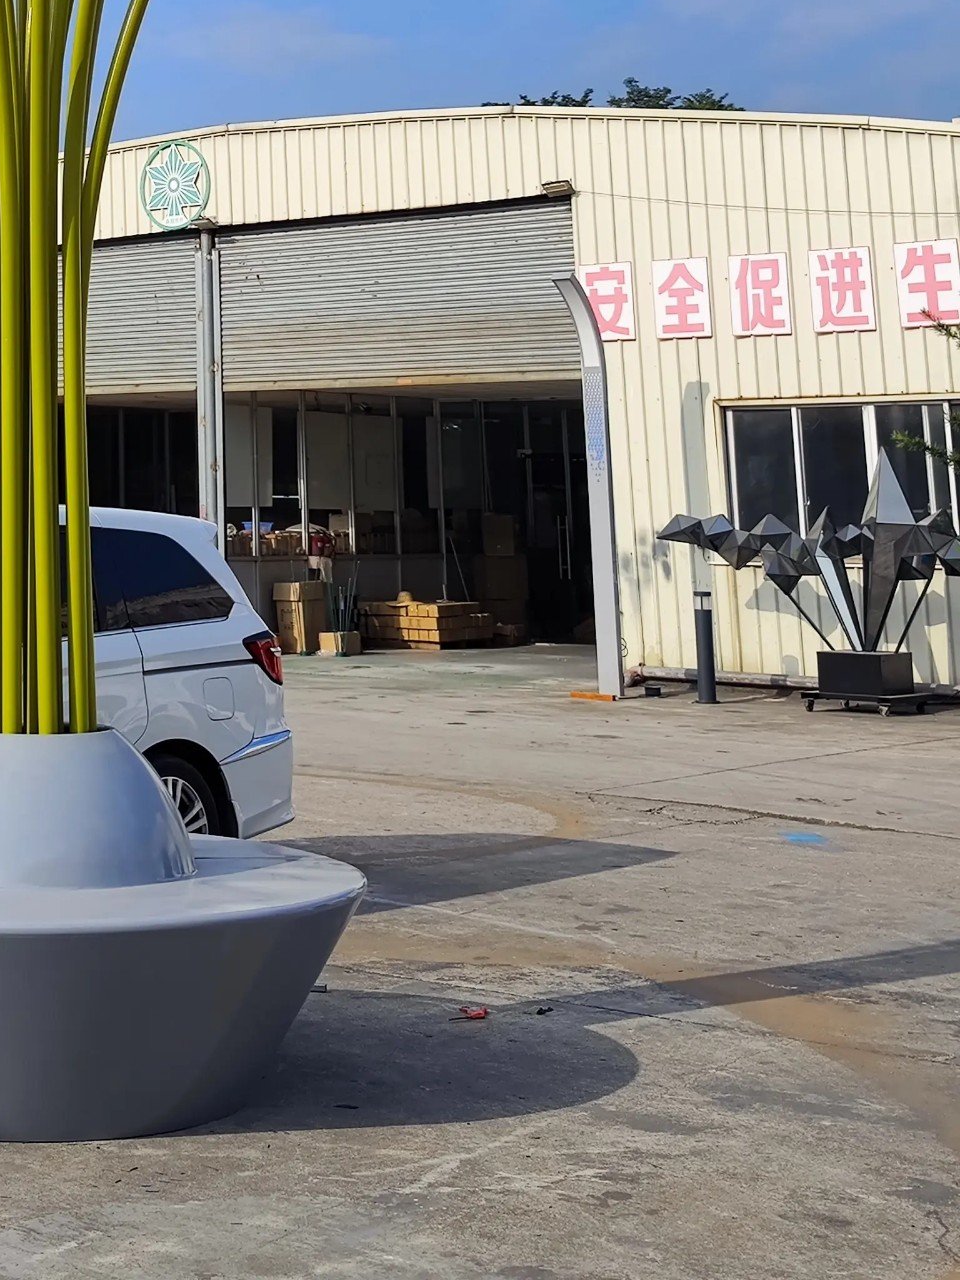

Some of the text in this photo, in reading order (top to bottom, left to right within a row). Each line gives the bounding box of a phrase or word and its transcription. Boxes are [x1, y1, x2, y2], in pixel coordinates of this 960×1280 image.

[585, 244, 960, 337] 安全促进生
